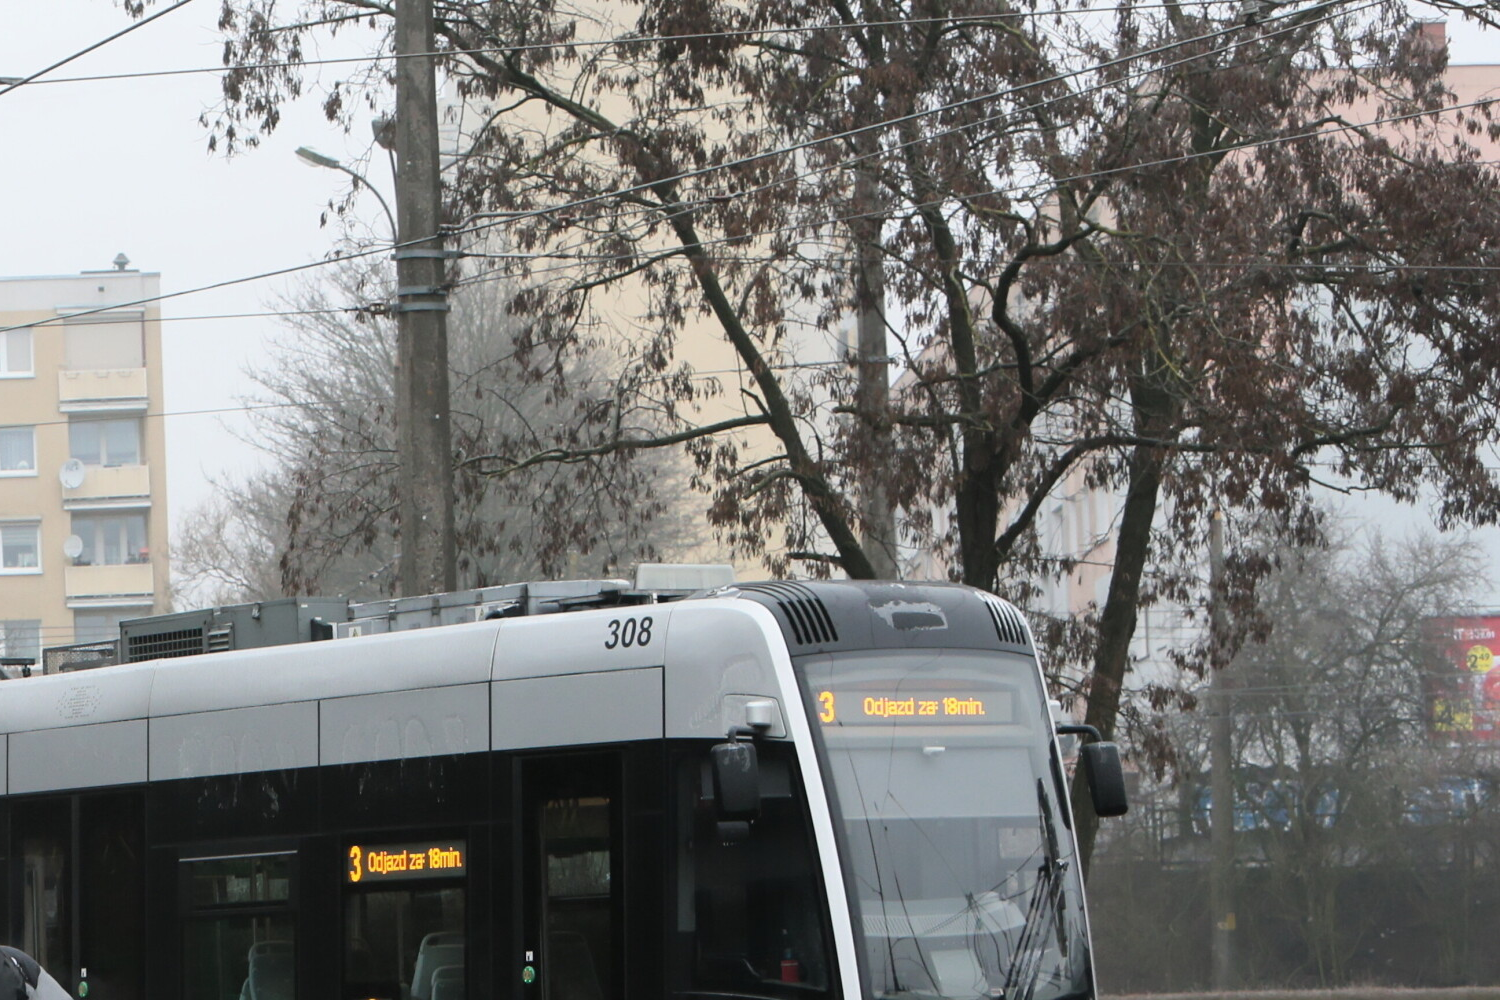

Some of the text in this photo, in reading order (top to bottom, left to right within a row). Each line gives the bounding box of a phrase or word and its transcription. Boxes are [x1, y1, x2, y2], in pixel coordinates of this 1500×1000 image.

[604, 616, 653, 650] 308
[819, 691, 835, 723] 3
[863, 697, 915, 717] Odjazd
[942, 697, 985, 716] 18min.
[350, 845, 362, 882] 3
[368, 850, 407, 874] Odjazd
[428, 846, 462, 869] 18min.
